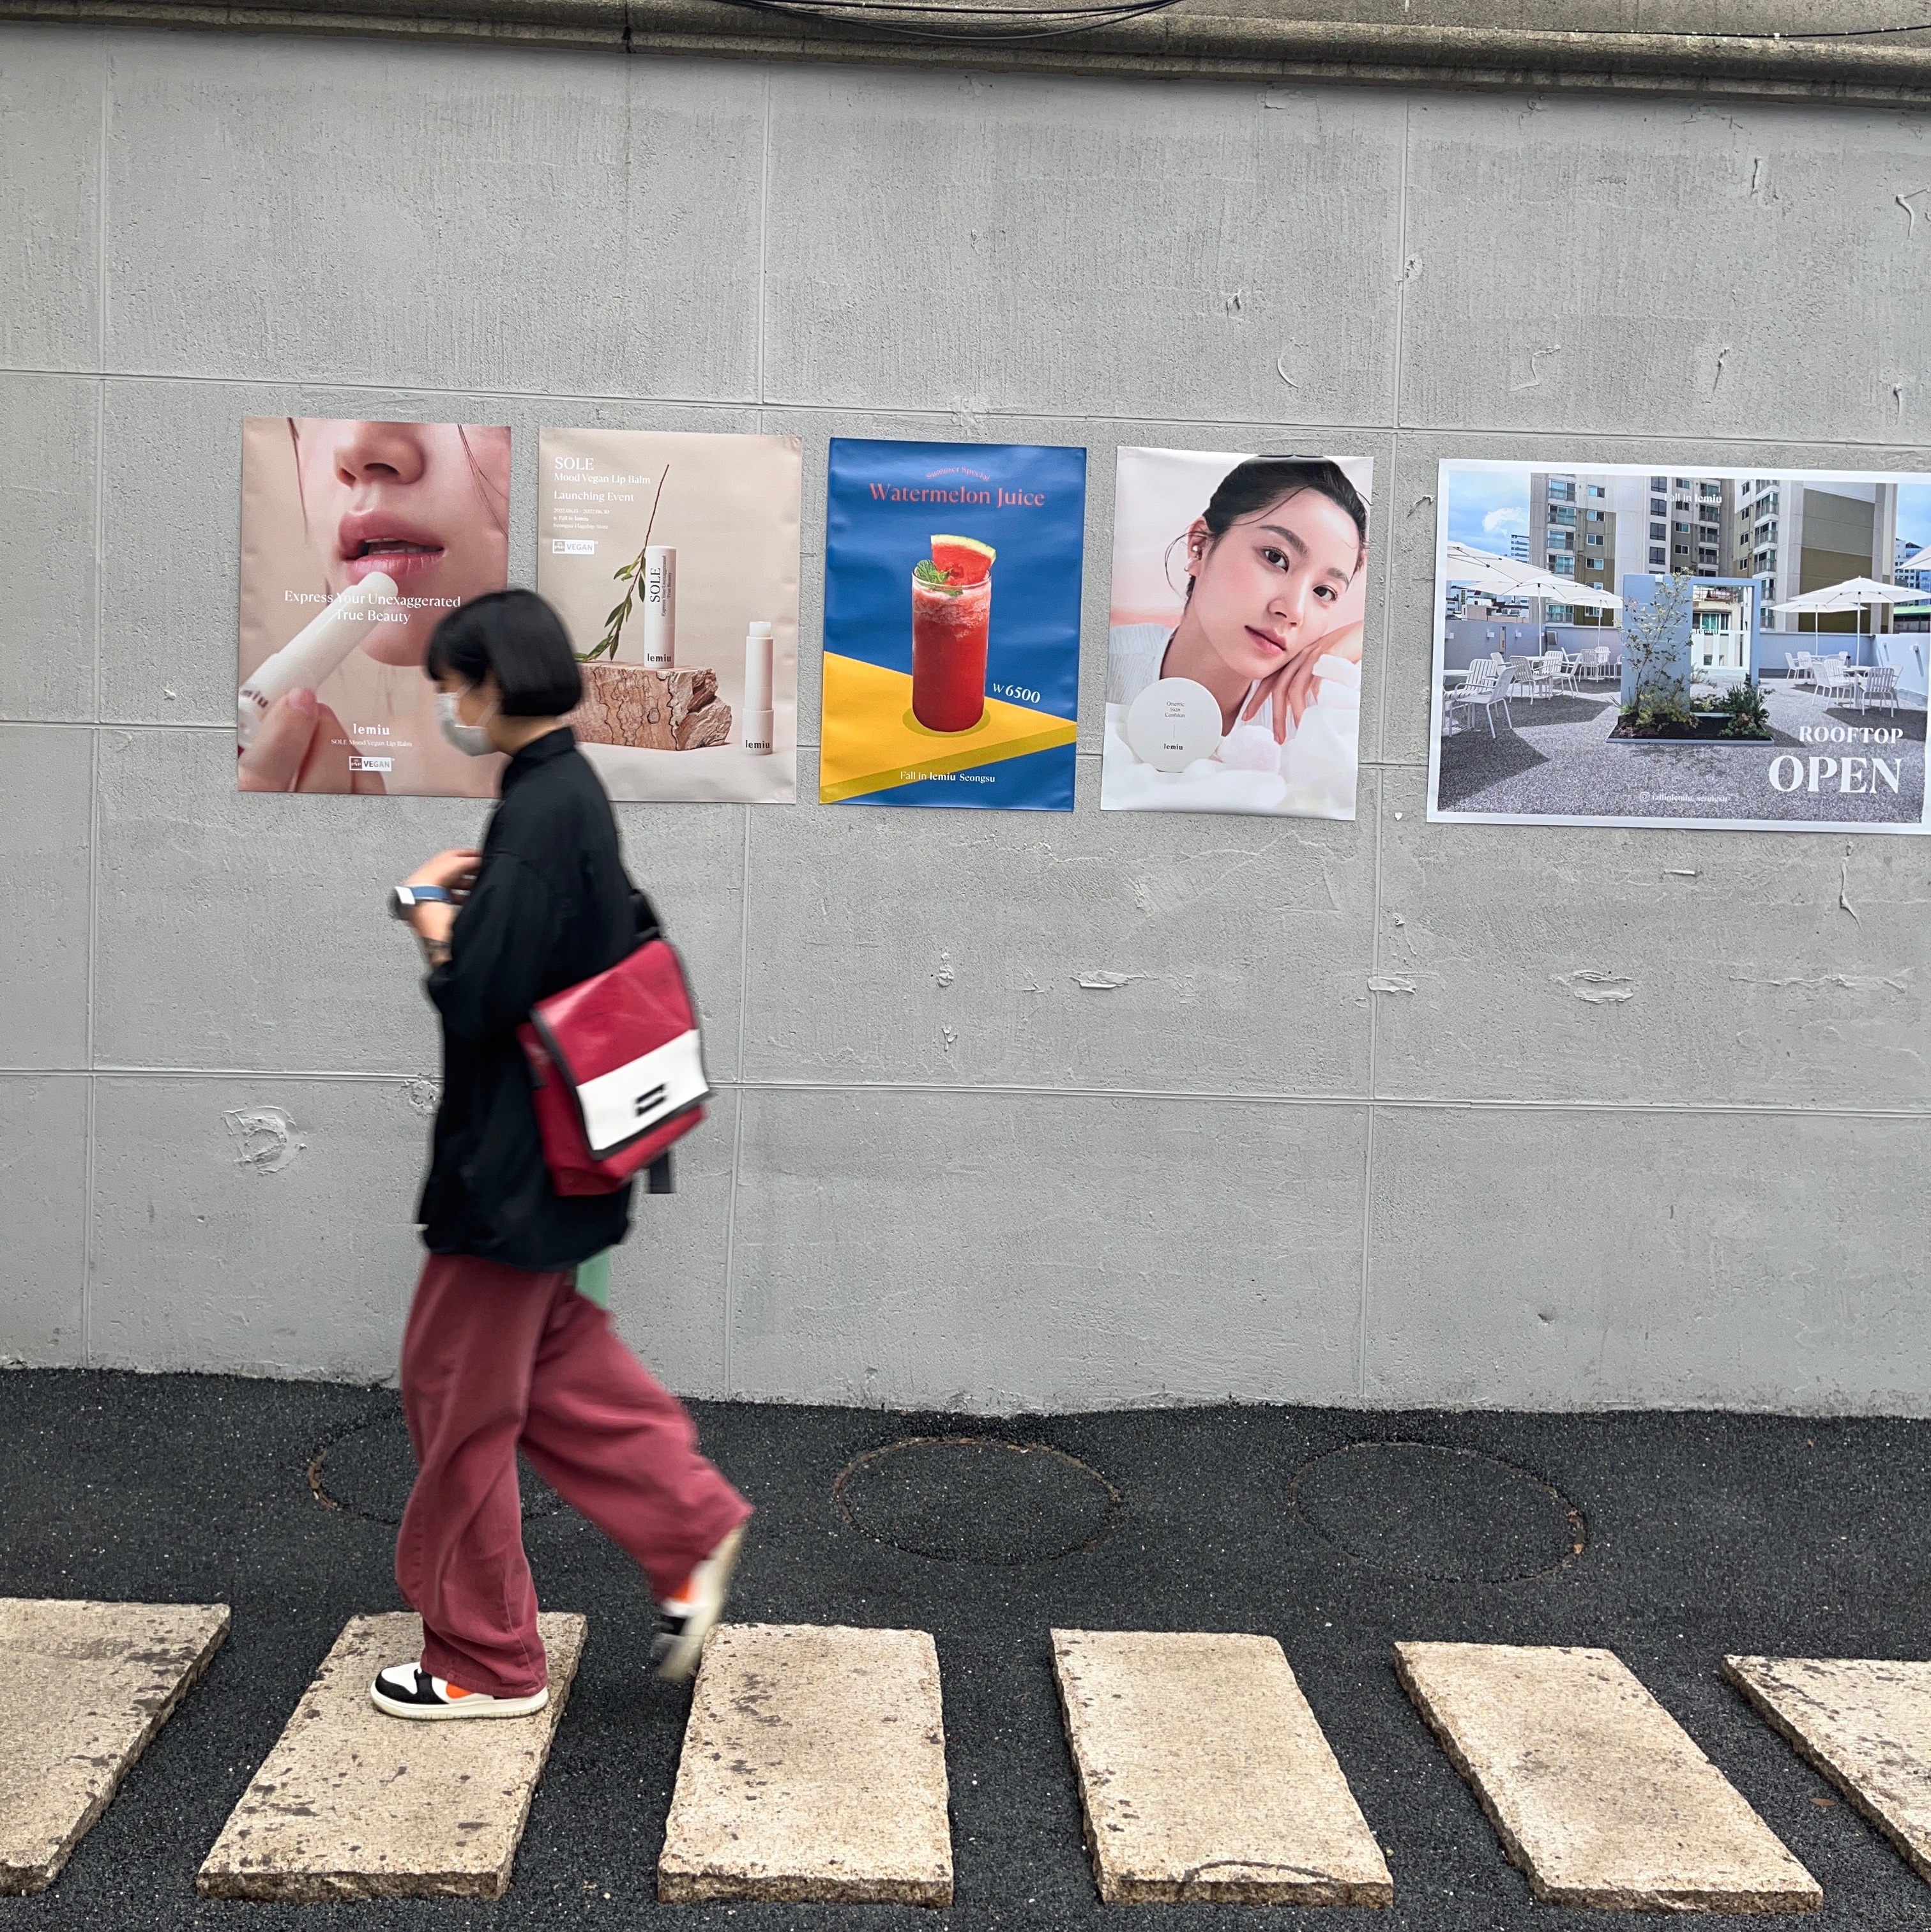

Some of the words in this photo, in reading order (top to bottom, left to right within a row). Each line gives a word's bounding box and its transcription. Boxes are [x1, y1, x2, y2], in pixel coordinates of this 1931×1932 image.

[555, 457, 594, 470] SOLE
[554, 473, 580, 482] Mood
[582, 473, 609, 484] Vegan
[612, 475, 626, 485] Lip
[628, 475, 651, 484] Balm
[554, 491, 605, 503] Launching
[607, 492, 634, 502] Event
[869, 482, 990, 504] Watermelon
[997, 487, 1045, 508] Juice
[1665, 492, 1680, 502] Fall
[1683, 494, 1692, 503] in
[1695, 494, 1722, 503] lemiu
[650, 568, 661, 602] SOLE
[285, 590, 333, 604] Express
[336, 592, 365, 604] Your
[368, 593, 461, 609] Unexaggerated
[335, 609, 364, 620] True
[367, 610, 411, 625] Beauty
[647, 653, 672, 662] lemiu
[1005, 685, 1041, 704] 6500
[352, 723, 390, 735] lemiu
[1799, 726, 1904, 744] ROOFTOP
[745, 740, 770, 749] lemiu
[900, 771, 916, 780] Fall
[918, 772, 927, 780] in
[930, 772, 956, 781] lemiu
[959, 773, 996, 784] Seongsu
[1769, 755, 1902, 794] OPEN
